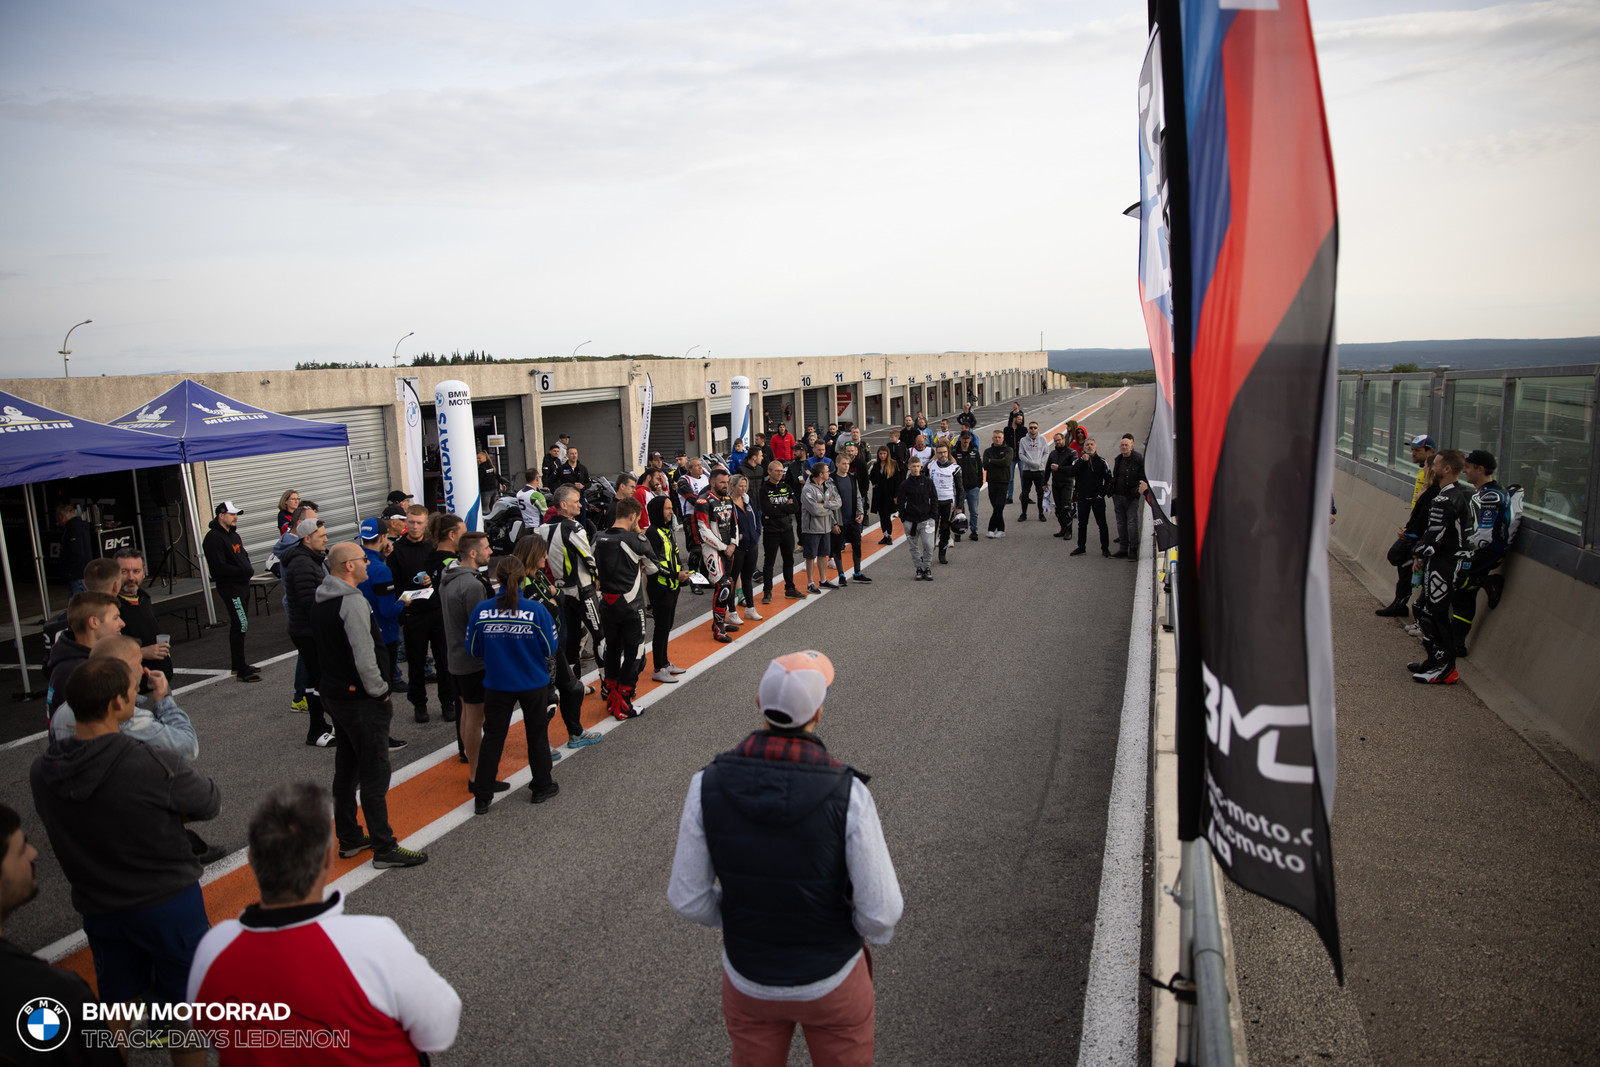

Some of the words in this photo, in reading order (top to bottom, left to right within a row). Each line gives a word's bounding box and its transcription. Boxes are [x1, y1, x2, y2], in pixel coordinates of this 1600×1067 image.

[835, 373, 843, 382] 11
[863, 371, 871, 380] 12
[925, 374, 932, 382] 15
[541, 374, 550, 391] 6
[762, 379, 769, 390] 9
[801, 376, 811, 387] 10
[710, 382, 717, 395] 8
[204, 415, 268, 425] MICHELIN
[0, 422, 74, 434] ICHELIN
[105, 536, 130, 550] BMC
[479, 609, 534, 621] SUZUKI
[483, 624, 533, 634] ECSTAR
